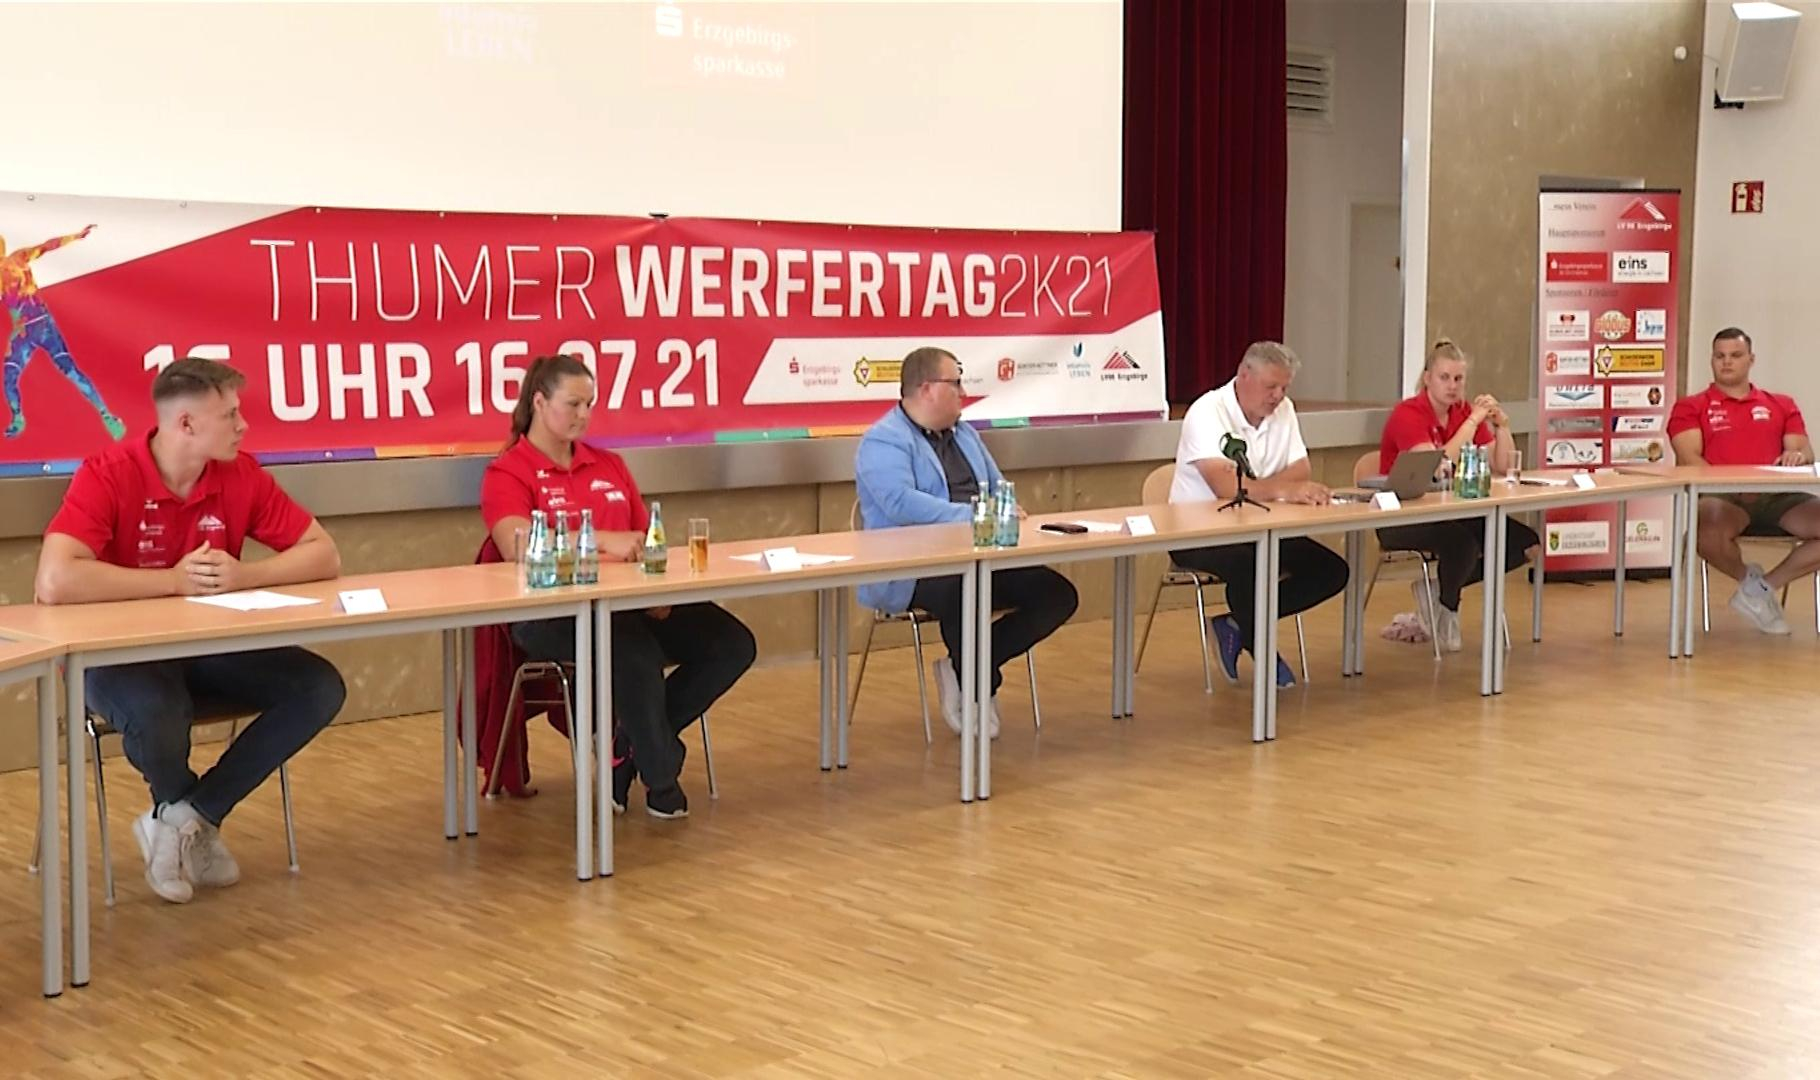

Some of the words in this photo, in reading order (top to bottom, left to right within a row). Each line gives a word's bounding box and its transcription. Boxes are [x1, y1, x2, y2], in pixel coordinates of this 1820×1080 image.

[693, 53, 785, 80] sparkasse
[250, 239, 597, 322] THUMER
[1617, 254, 1648, 270] eins
[267, 341, 435, 421] UHR
